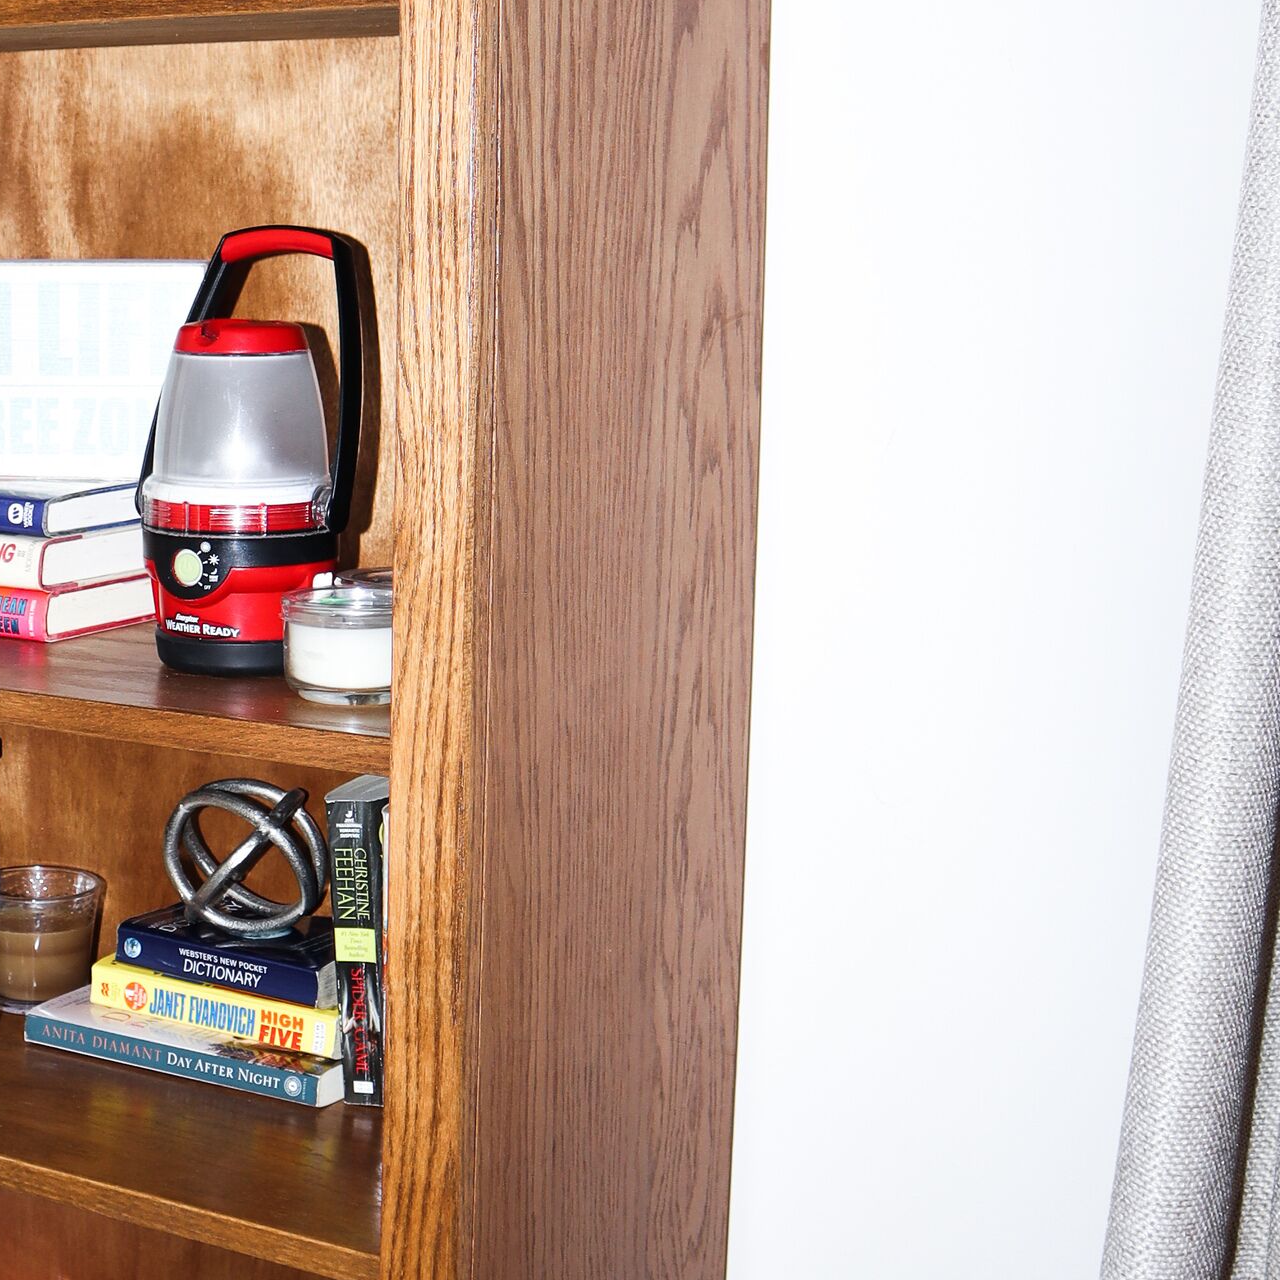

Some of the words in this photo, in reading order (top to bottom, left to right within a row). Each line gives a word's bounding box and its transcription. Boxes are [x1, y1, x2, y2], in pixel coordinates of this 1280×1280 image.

[165, 618, 201, 635] WEATHER
[202, 623, 240, 638] READY
[334, 848, 357, 920] FEEHAN
[354, 847, 370, 921] CHRISTINE
[179, 947, 218, 964] WEBSTER'S
[220, 957, 238, 968] NEW
[239, 960, 268, 974] POCKET
[183, 959, 262, 988] DICTIONARY
[351, 968, 368, 1022] SPIDER
[149, 988, 186, 1019] JANET
[189, 995, 256, 1037] EVANOVICH
[261, 1009, 304, 1031] HIGH
[42, 1024, 86, 1045] ANITA
[92, 1035, 162, 1062] DIAMANT
[258, 1024, 303, 1052] FIVE
